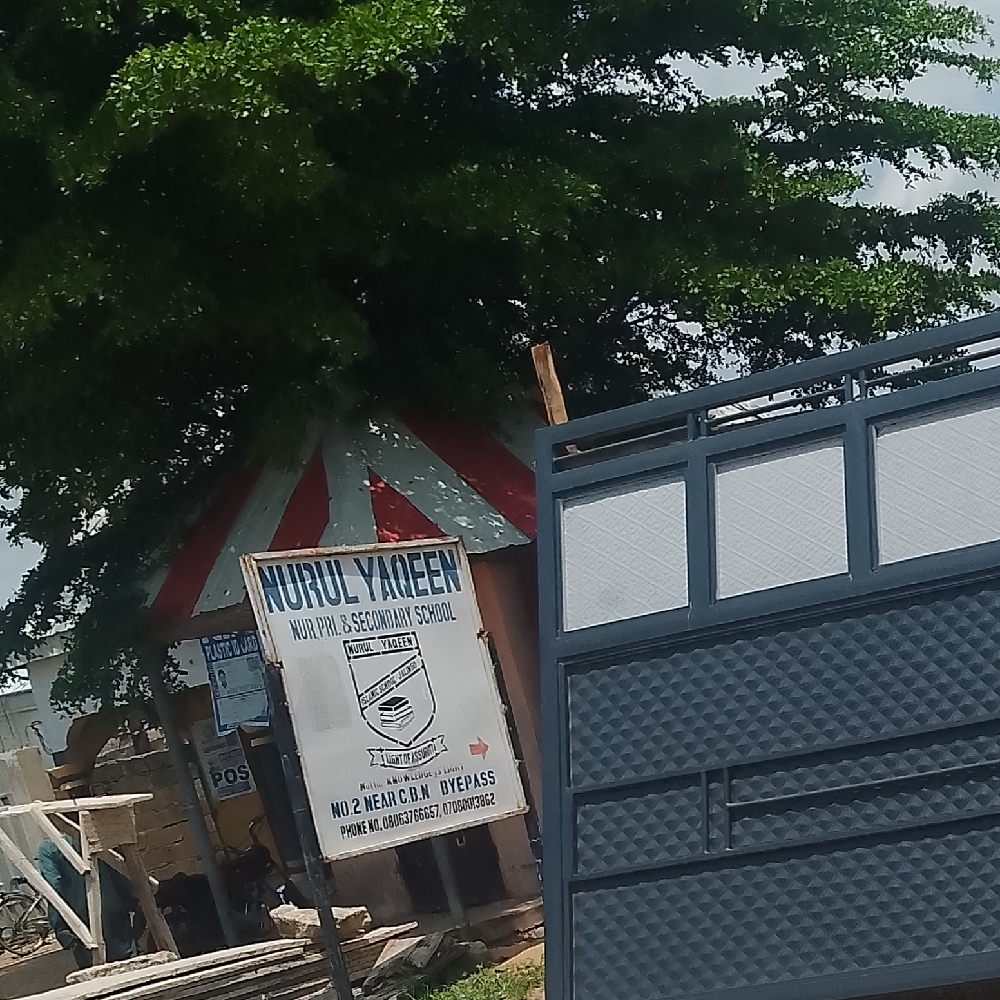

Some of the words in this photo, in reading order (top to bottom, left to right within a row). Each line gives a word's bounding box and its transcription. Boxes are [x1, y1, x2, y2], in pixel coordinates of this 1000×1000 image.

[257, 559, 360, 614] NURUL
[354, 549, 461, 602] YAQEEN
[342, 613, 353, 635] &
[351, 606, 413, 634] SECONDARY
[414, 601, 456, 627] SCHOOL
[347, 642, 374, 655] NURUL
[381, 636, 413, 650] YAQEEN
[211, 765, 250, 788] POS
[364, 789, 397, 813] NEAR
[440, 770, 496, 797] BYEPASS
[340, 821, 367, 840] PHONE
